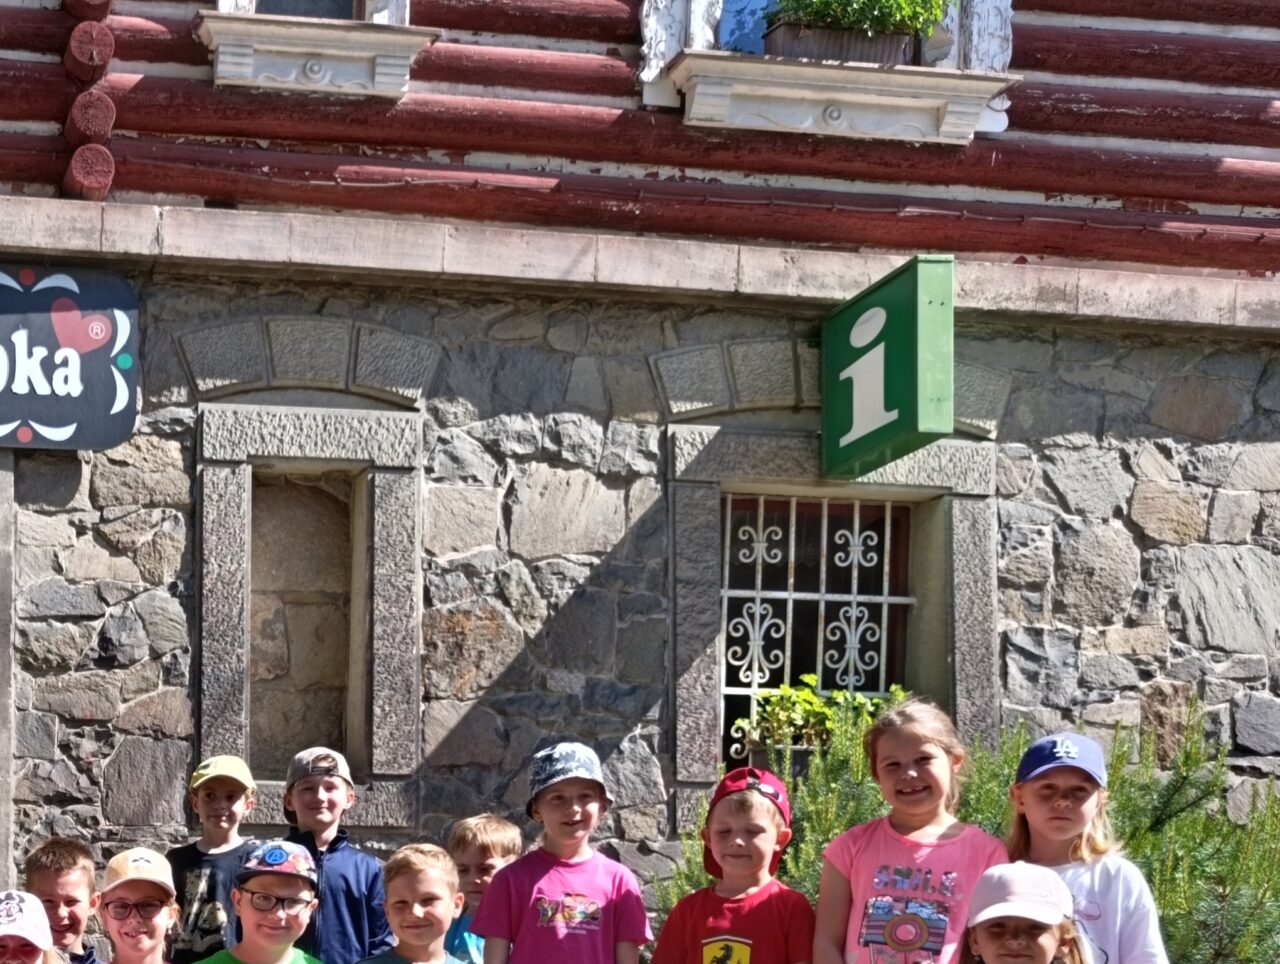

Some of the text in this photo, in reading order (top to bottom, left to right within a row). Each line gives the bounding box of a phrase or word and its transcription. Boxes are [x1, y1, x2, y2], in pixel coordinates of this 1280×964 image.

[839, 306, 899, 448] i
[1053, 736, 1078, 758] LA
[873, 865, 958, 896] SMILE
